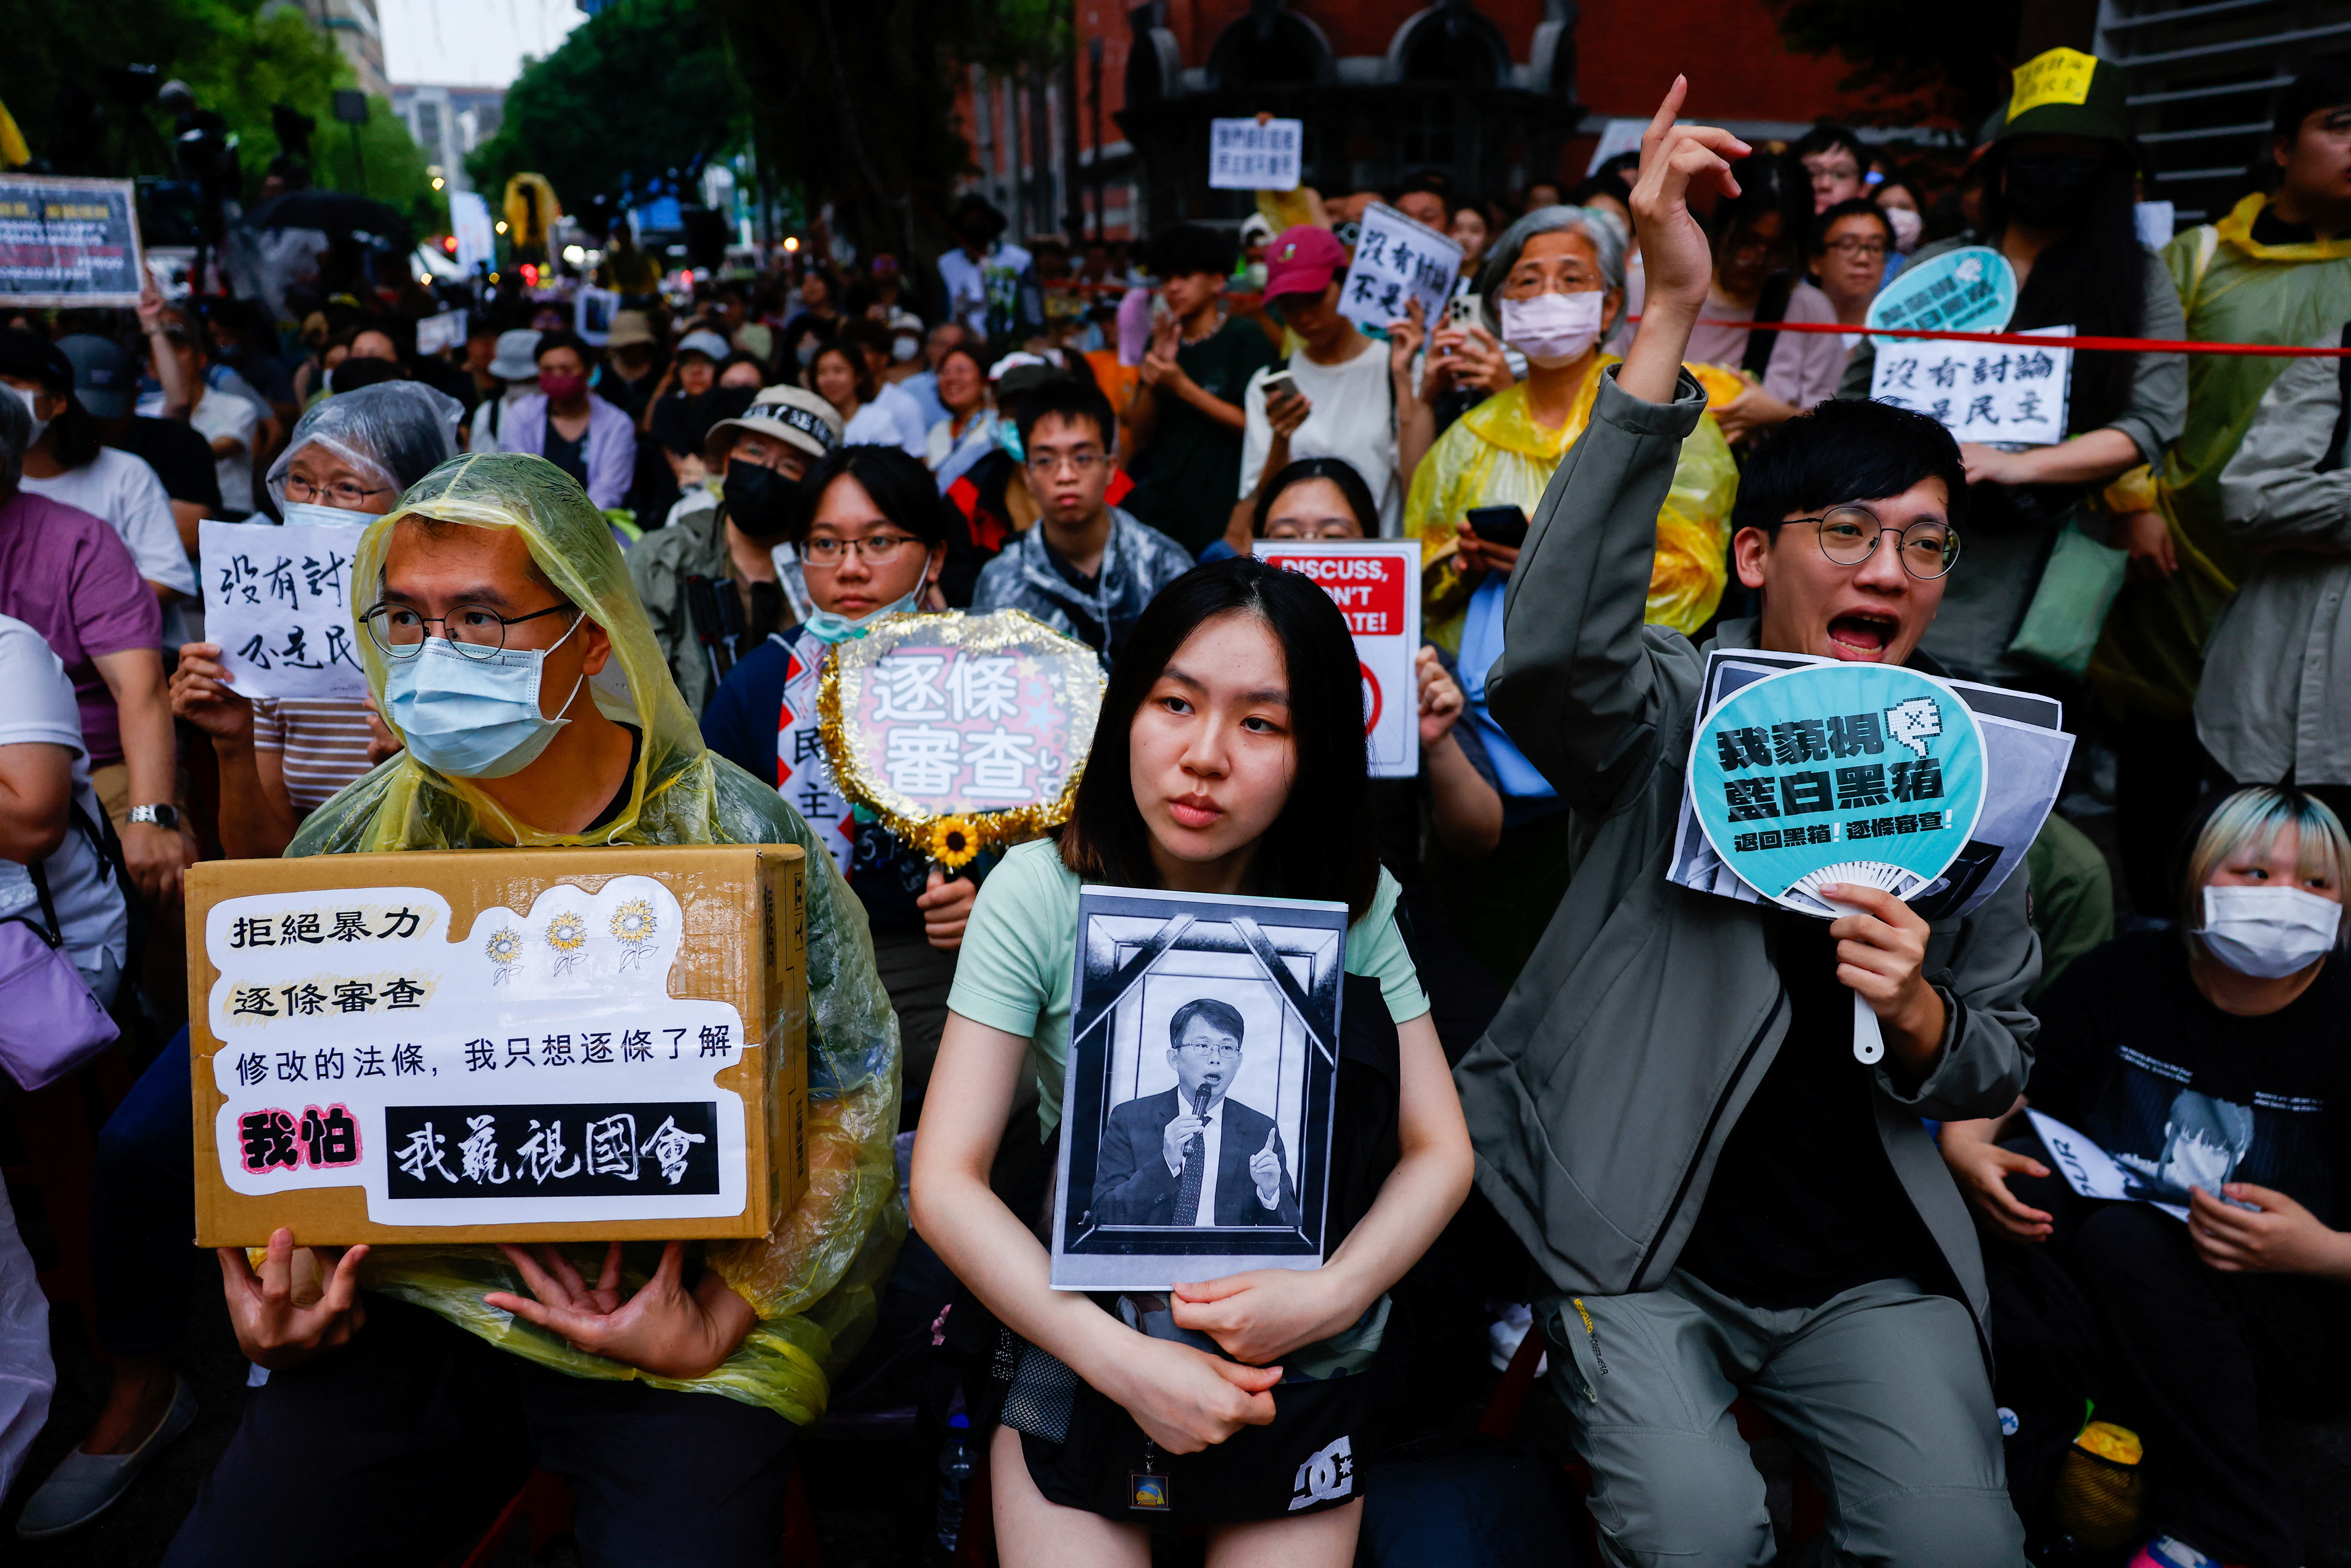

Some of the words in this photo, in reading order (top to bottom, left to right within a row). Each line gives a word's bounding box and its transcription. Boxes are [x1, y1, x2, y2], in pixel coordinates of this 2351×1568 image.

[1881, 350, 2054, 389] 沒有討論
[1887, 391, 2049, 428] 是民主
[220, 550, 356, 611] 沒有討
[1321, 585, 1373, 606] N'T
[237, 625, 364, 674] 不是民
[872, 652, 1019, 722] 逐條
[885, 723, 1036, 798] 審查
[1716, 712, 1884, 772] 我藐視
[1724, 758, 1944, 823] 藍白黑箱
[230, 907, 420, 948] 拒絕暴力
[233, 977, 426, 1017] 逐條審查
[241, 1107, 357, 1170] 我怕
[1288, 1435, 1353, 1511] DC
